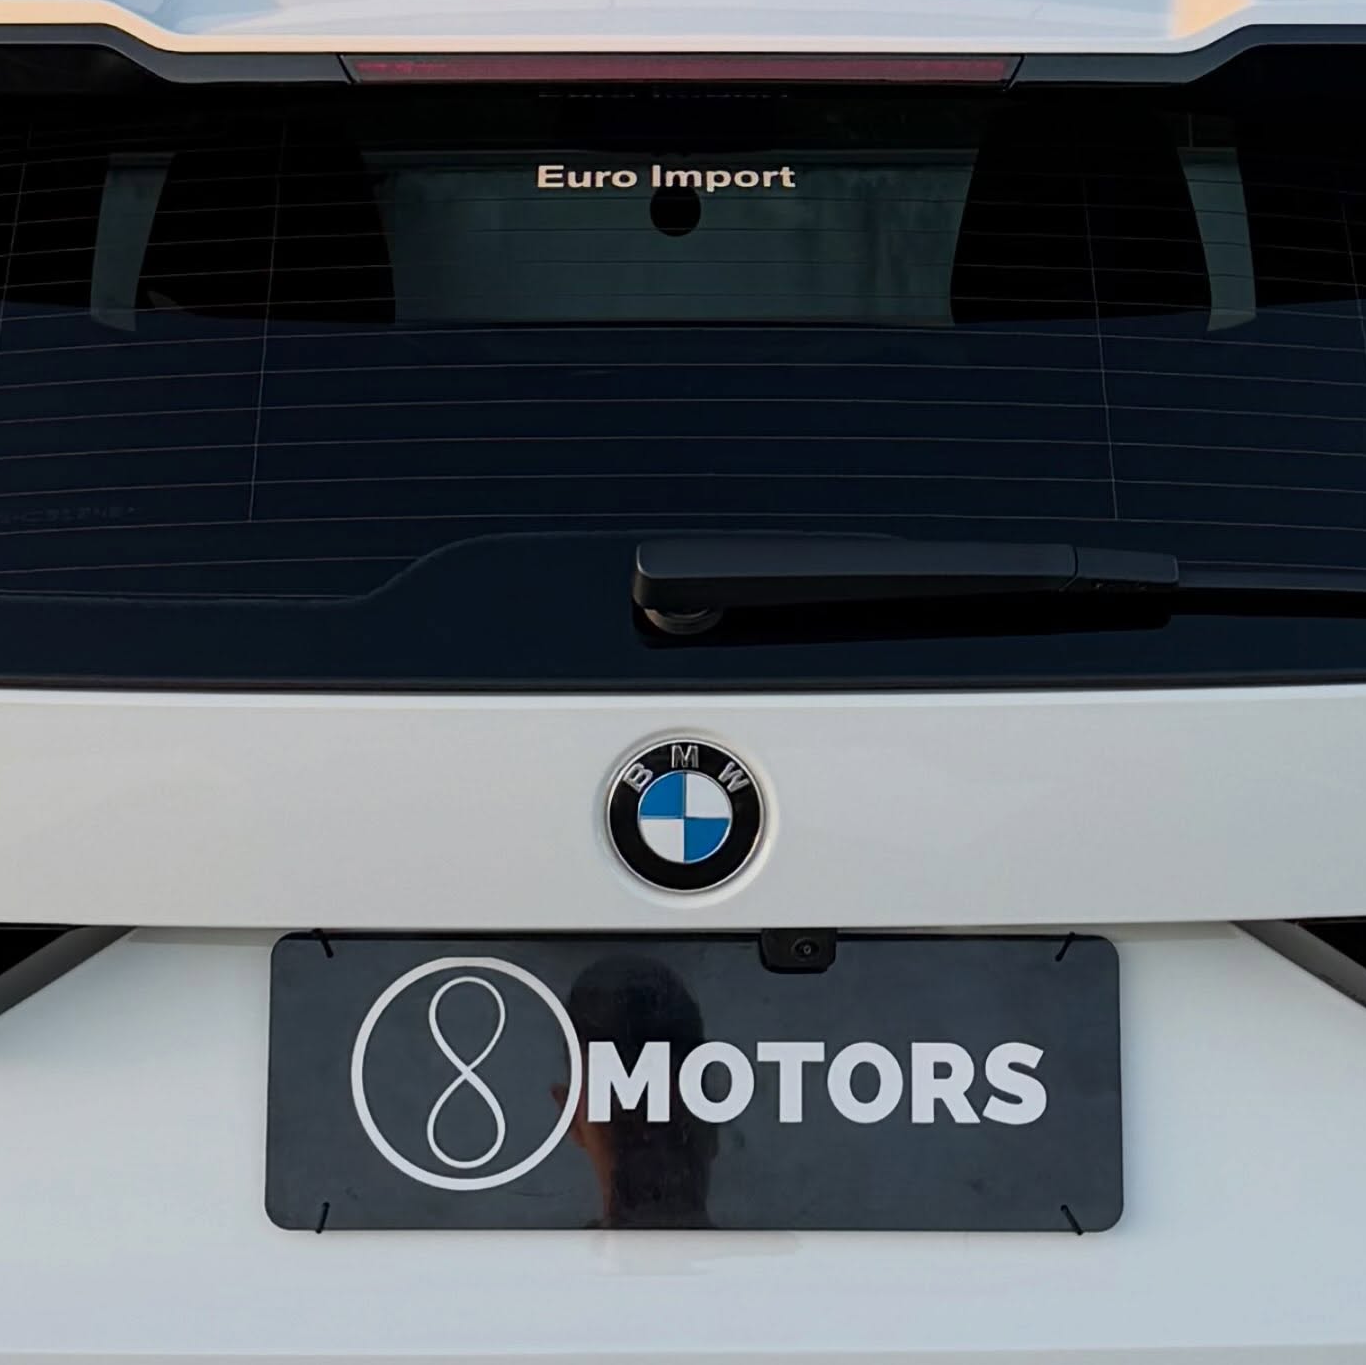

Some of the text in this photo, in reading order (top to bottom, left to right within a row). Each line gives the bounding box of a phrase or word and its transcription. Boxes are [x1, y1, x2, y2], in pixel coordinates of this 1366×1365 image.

[537, 165, 796, 193] Euro Import
[623, 744, 750, 794] BMW
[587, 1041, 1047, 1124] MOTORS
